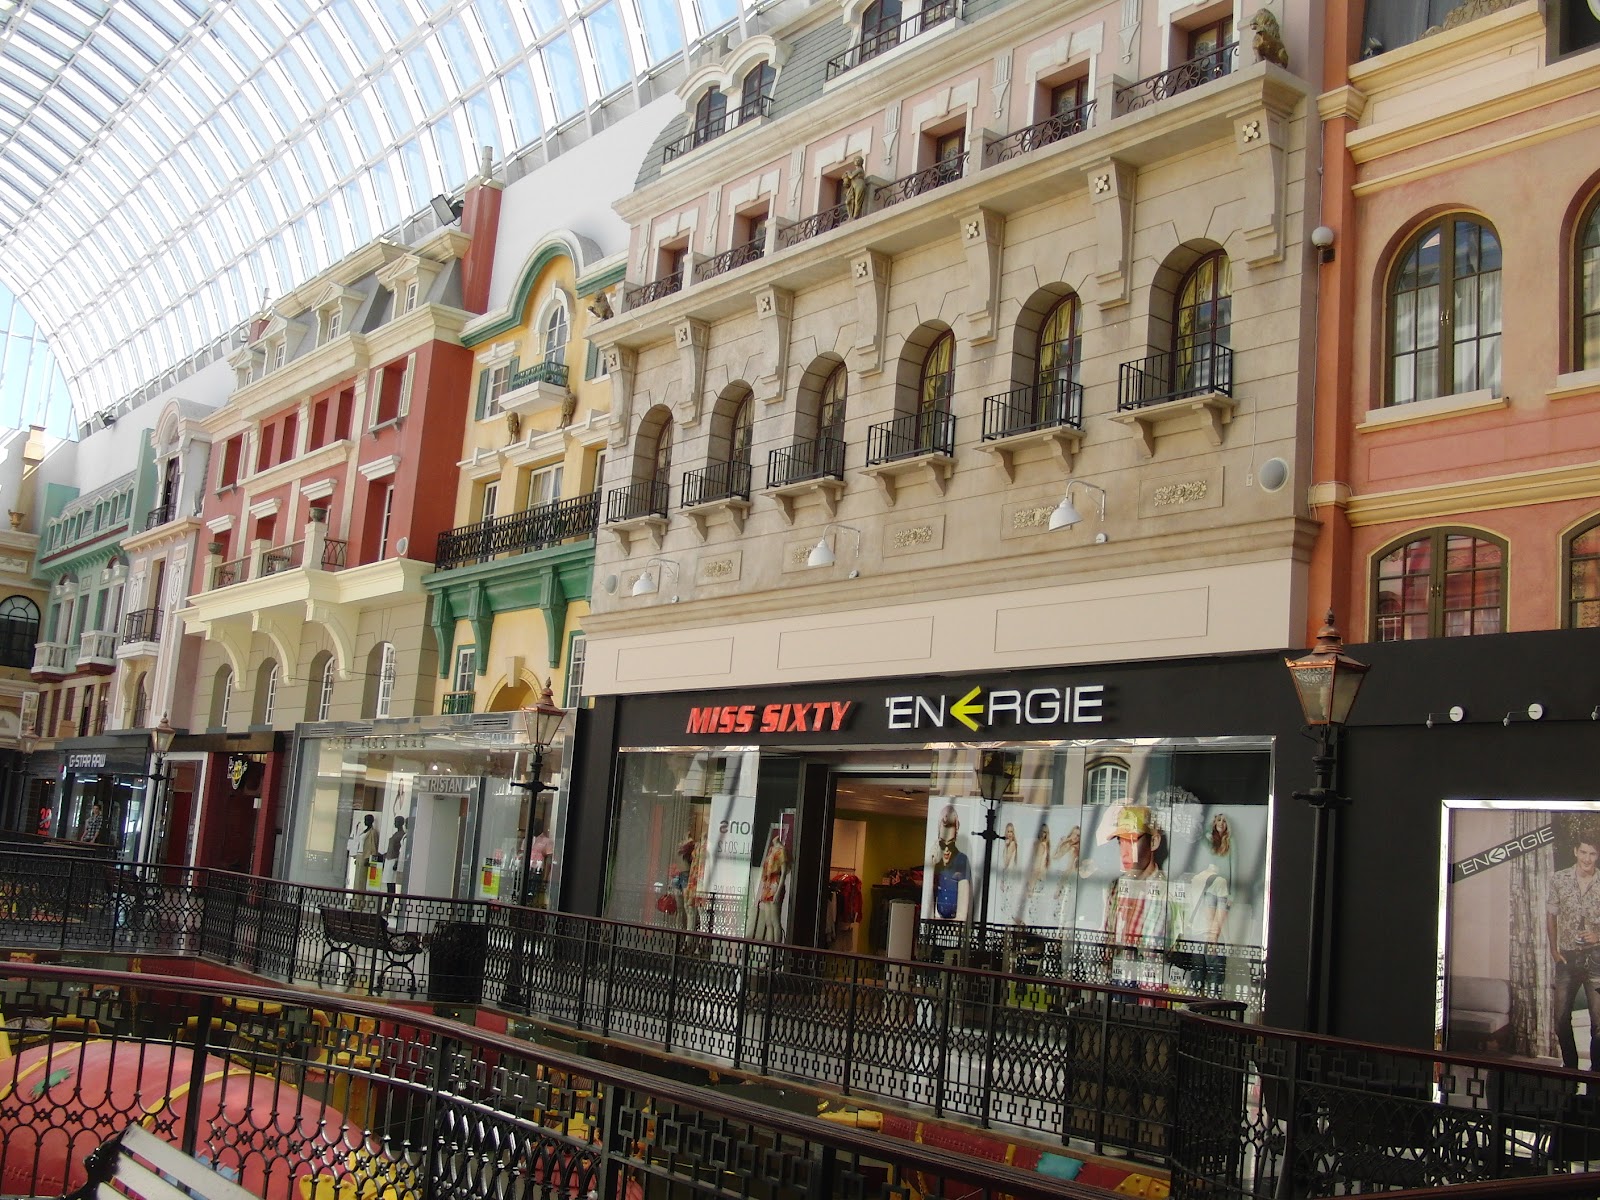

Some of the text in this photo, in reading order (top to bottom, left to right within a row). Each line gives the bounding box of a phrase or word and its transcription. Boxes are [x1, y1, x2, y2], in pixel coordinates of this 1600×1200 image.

[685, 700, 852, 734] MISS SIXTY
[69, 753, 107, 768] G-STAR RAW
[426, 777, 463, 793] TRISTAN
